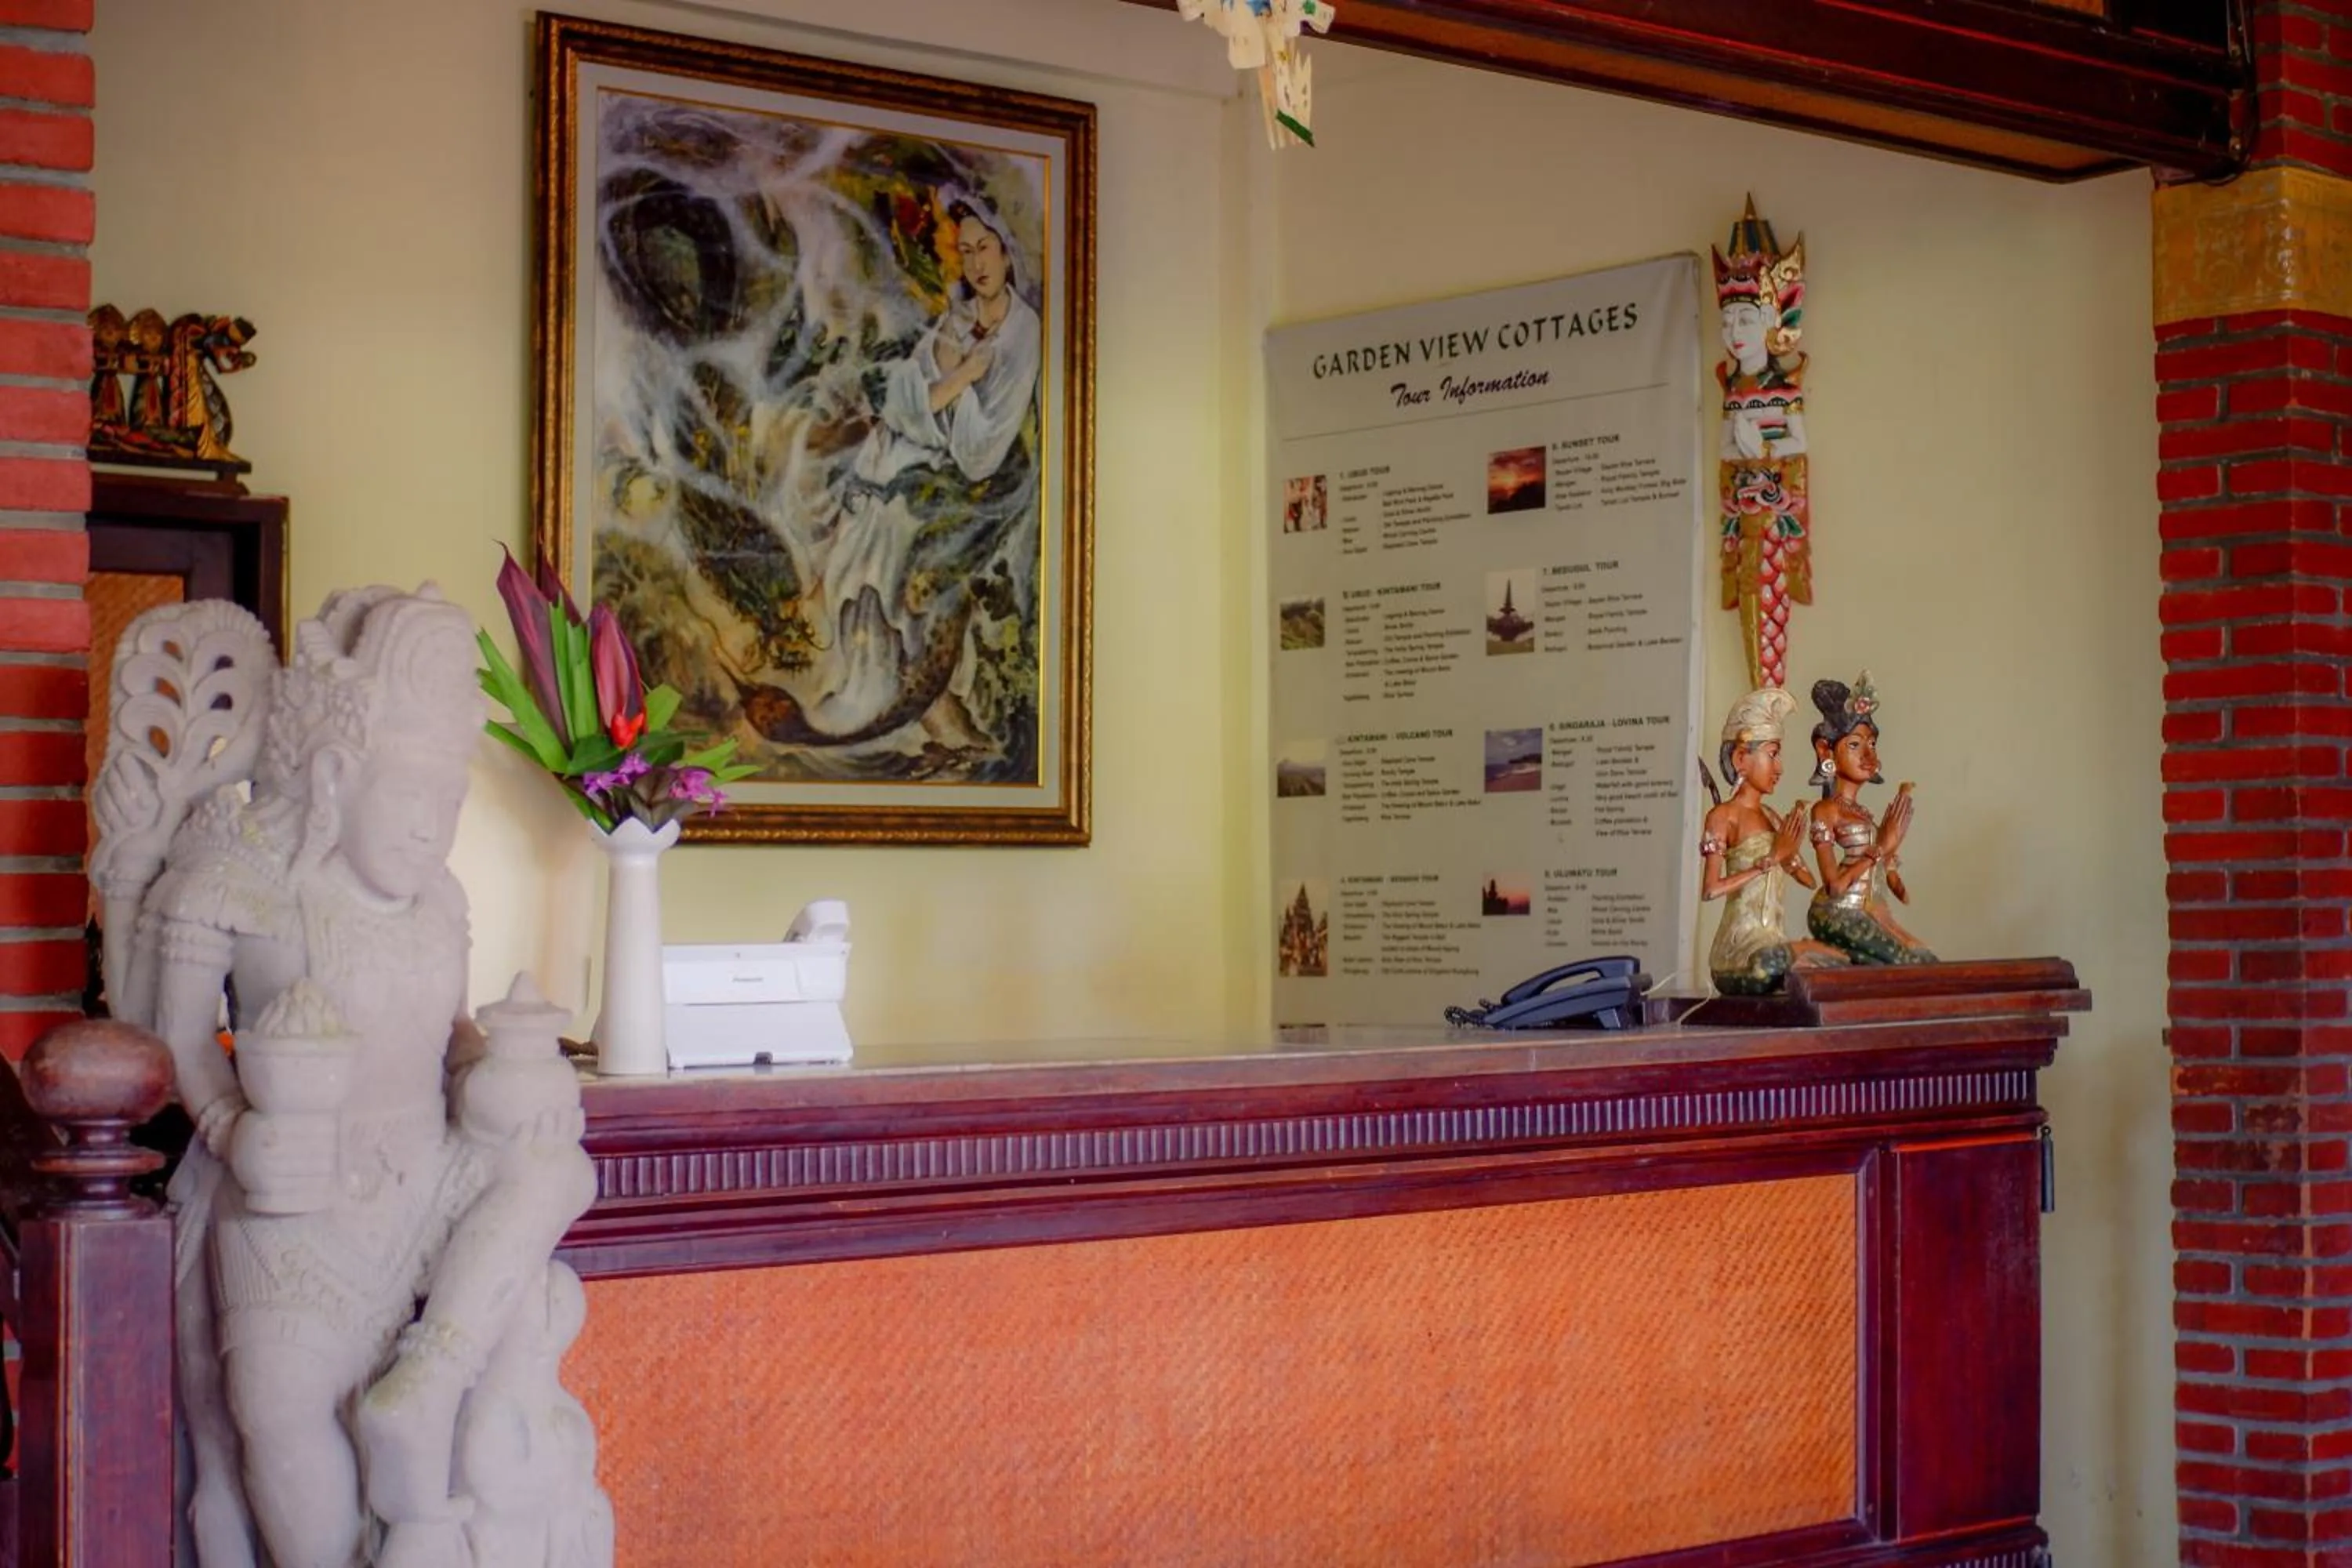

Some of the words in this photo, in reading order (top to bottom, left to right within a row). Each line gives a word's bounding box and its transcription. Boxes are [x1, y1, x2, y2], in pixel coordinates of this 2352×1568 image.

[1313, 342, 1410, 379] GARDEN
[1419, 327, 1490, 361] VIEW
[1497, 303, 1639, 350] COTTAGES
[1390, 383, 1431, 408] Tour
[1439, 369, 1550, 405] Information
[1561, 437, 1594, 449] SUNSET
[1597, 434, 1620, 445] TOUR
[1595, 560, 1619, 571] TOUR
[1612, 717, 1643, 728] LOVINA
[1646, 716, 1670, 726] TOUR
[1396, 730, 1431, 740] VOLCANO
[1432, 728, 1453, 739] TOUR
[1595, 867, 1617, 877] TOUR
